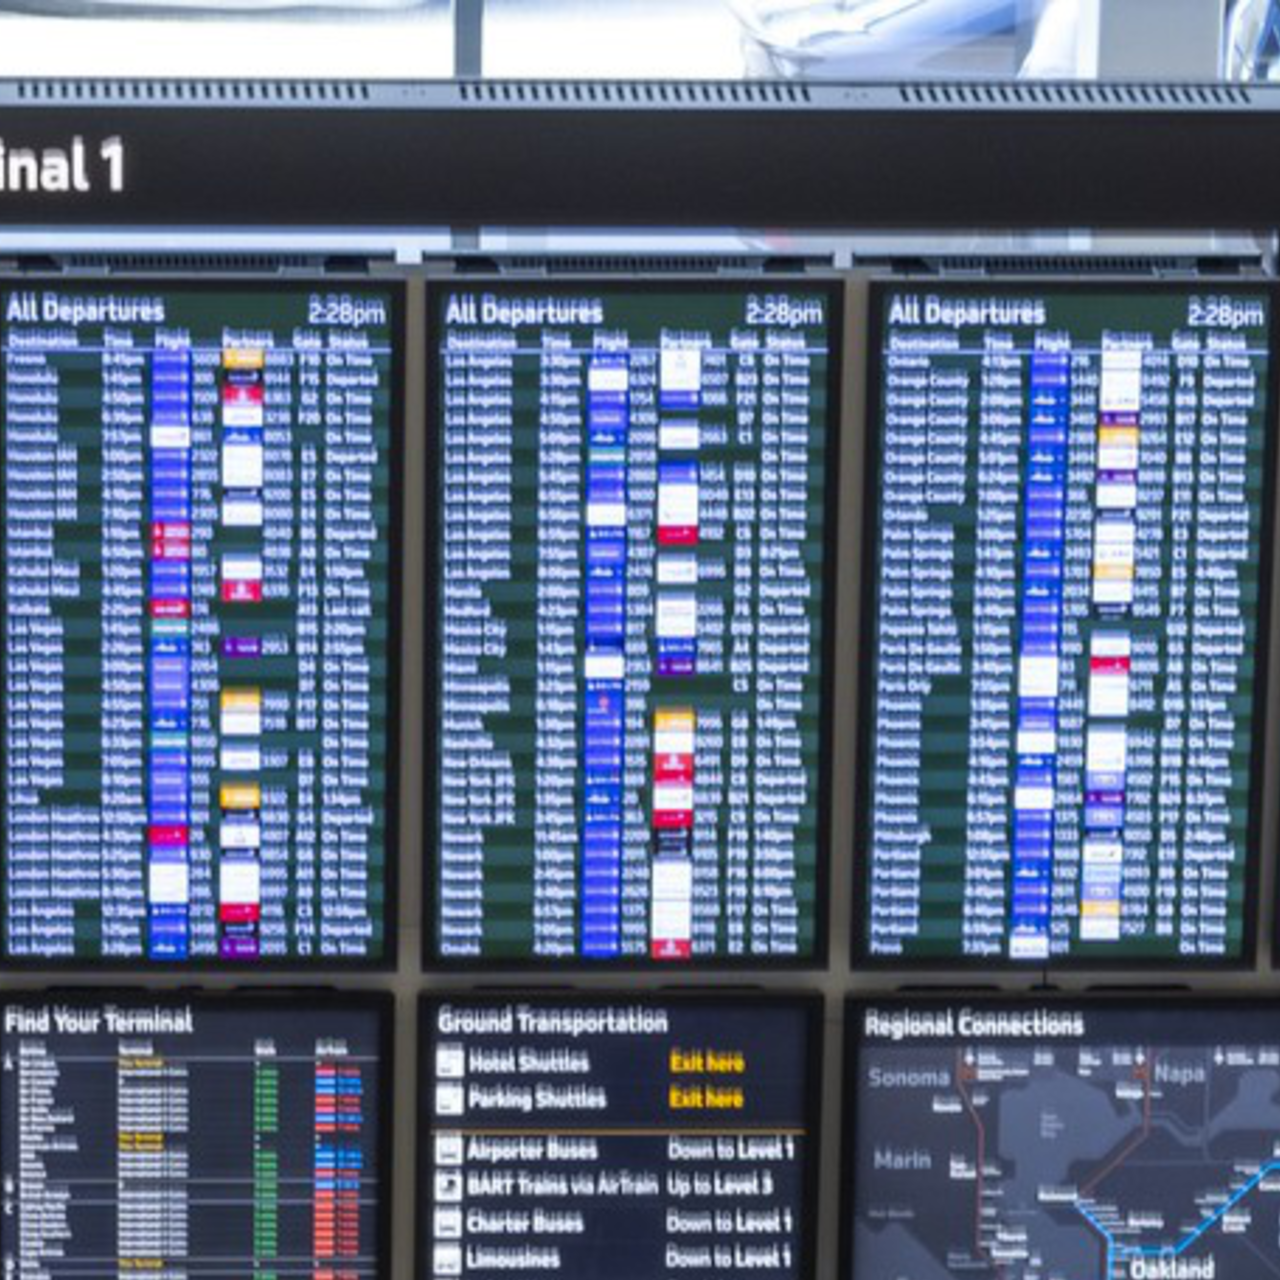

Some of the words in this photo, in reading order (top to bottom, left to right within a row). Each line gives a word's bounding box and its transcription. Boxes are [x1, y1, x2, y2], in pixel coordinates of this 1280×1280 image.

[100, 138, 125, 191] 1
[7, 296, 39, 321] All
[43, 296, 165, 326] Departures
[309, 298, 385, 326] 2:28pm
[446, 298, 476, 323] All
[483, 298, 603, 328] Departures
[747, 299, 823, 326] 2:28pm
[889, 299, 920, 324] All
[926, 299, 1046, 328] Departures
[1189, 300, 1264, 328] 2:28pm
[5, 1008, 49, 1033] Find
[55, 1008, 100, 1033] Your
[104, 1008, 193, 1033] Terminal
[438, 1009, 513, 1033] Ground
[519, 1009, 668, 1037] Transportation
[866, 1011, 954, 1040] Regional
[959, 1011, 1084, 1037] Connections
[469, 1049, 515, 1072] Hotel
[519, 1049, 589, 1072] Shuttles
[669, 1049, 703, 1072] Exit
[707, 1049, 745, 1072] here
[869, 1067, 950, 1087] Sonoma
[1155, 1064, 1205, 1084] Napa
[469, 1085, 533, 1113] Parking
[536, 1086, 607, 1109] Shuttles
[669, 1085, 703, 1108] Exit
[706, 1085, 744, 1108] here
[467, 1138, 544, 1164] Airporter
[548, 1138, 598, 1160] Buses
[668, 1137, 712, 1160] Down
[715, 1139, 736, 1160] to
[738, 1137, 782, 1160] Level
[785, 1138, 794, 1160] 1
[875, 1150, 931, 1170] Marin
[468, 1174, 514, 1196] BART
[517, 1173, 568, 1196] Trains
[571, 1174, 594, 1196] via
[598, 1173, 659, 1196] AirTrain
[466, 1247, 560, 1269] Limousines
[1130, 1257, 1214, 1280] Oakland
